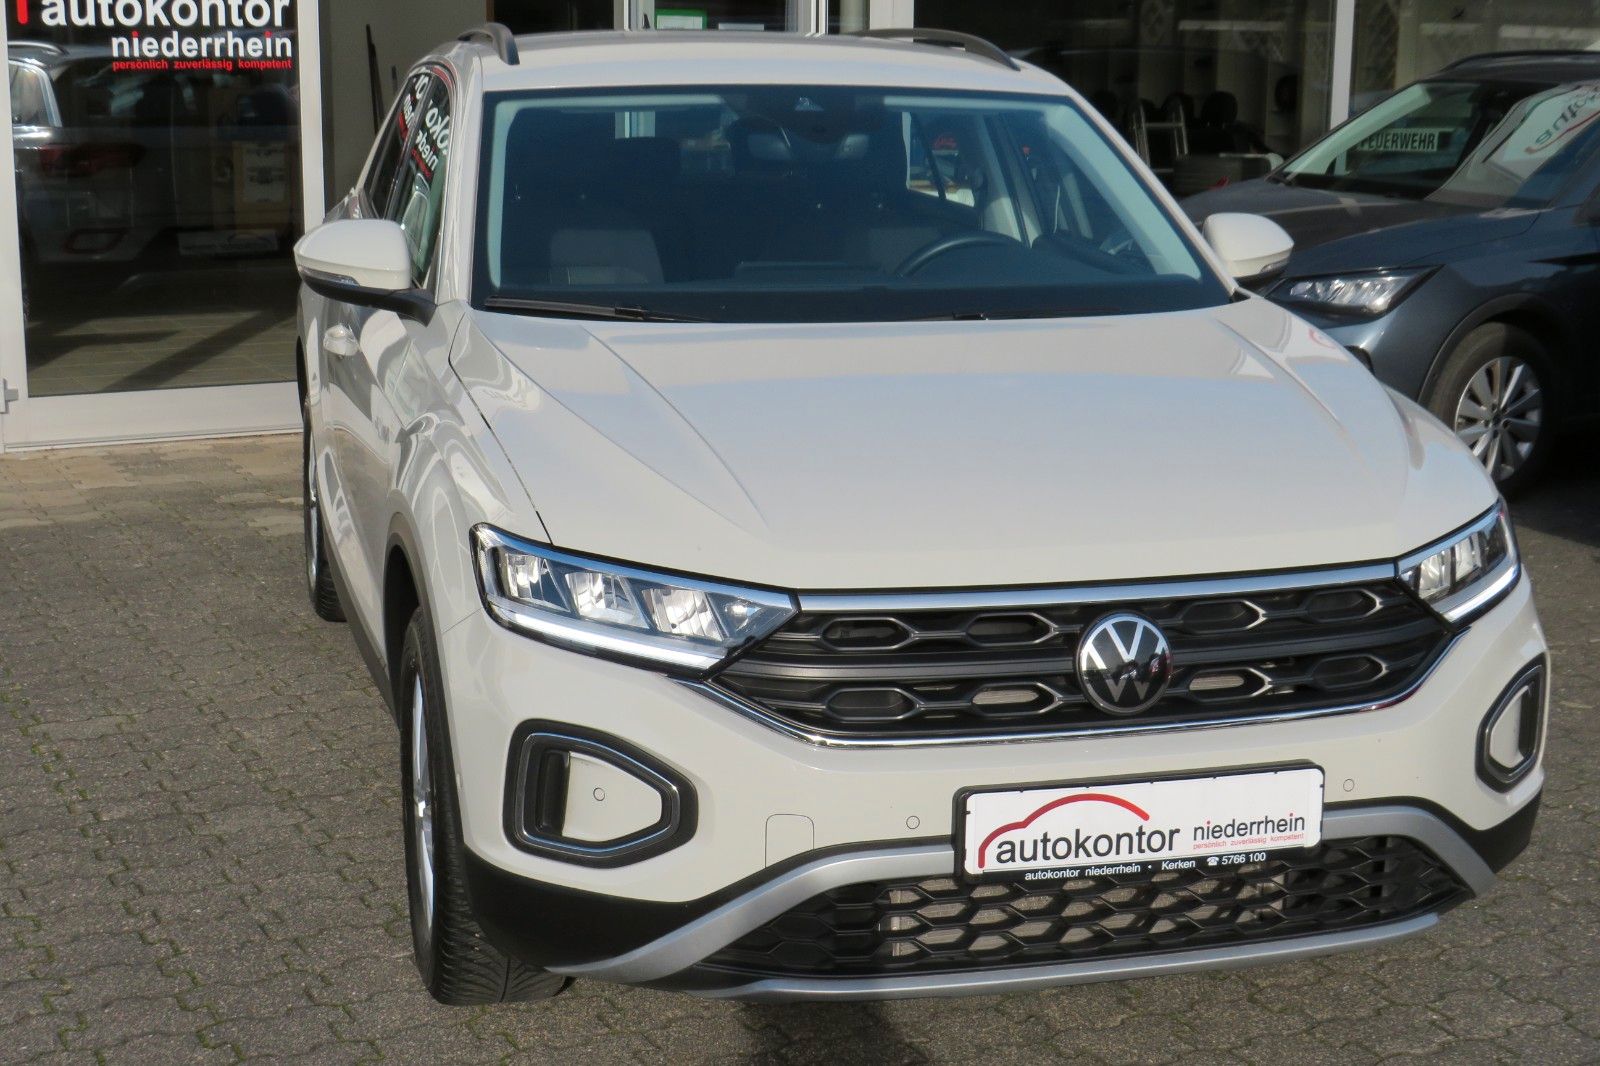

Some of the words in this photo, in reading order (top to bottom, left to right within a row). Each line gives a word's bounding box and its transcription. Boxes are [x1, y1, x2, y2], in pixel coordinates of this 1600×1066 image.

[40, 0, 290, 27] autokontor
[111, 31, 292, 58] niederrhein
[112, 59, 168, 71] persönlich
[173, 59, 233, 72] zuverlässig
[238, 58, 292, 71] kompetent
[996, 825, 1181, 863] autokontor
[1193, 812, 1305, 841] niederrhein
[1024, 868, 1080, 881] autokontor
[1085, 864, 1141, 877] niederrhein
[1161, 860, 1196, 871] Kerken
[1221, 853, 1246, 866] 5766
[1249, 852, 1266, 863] 100
